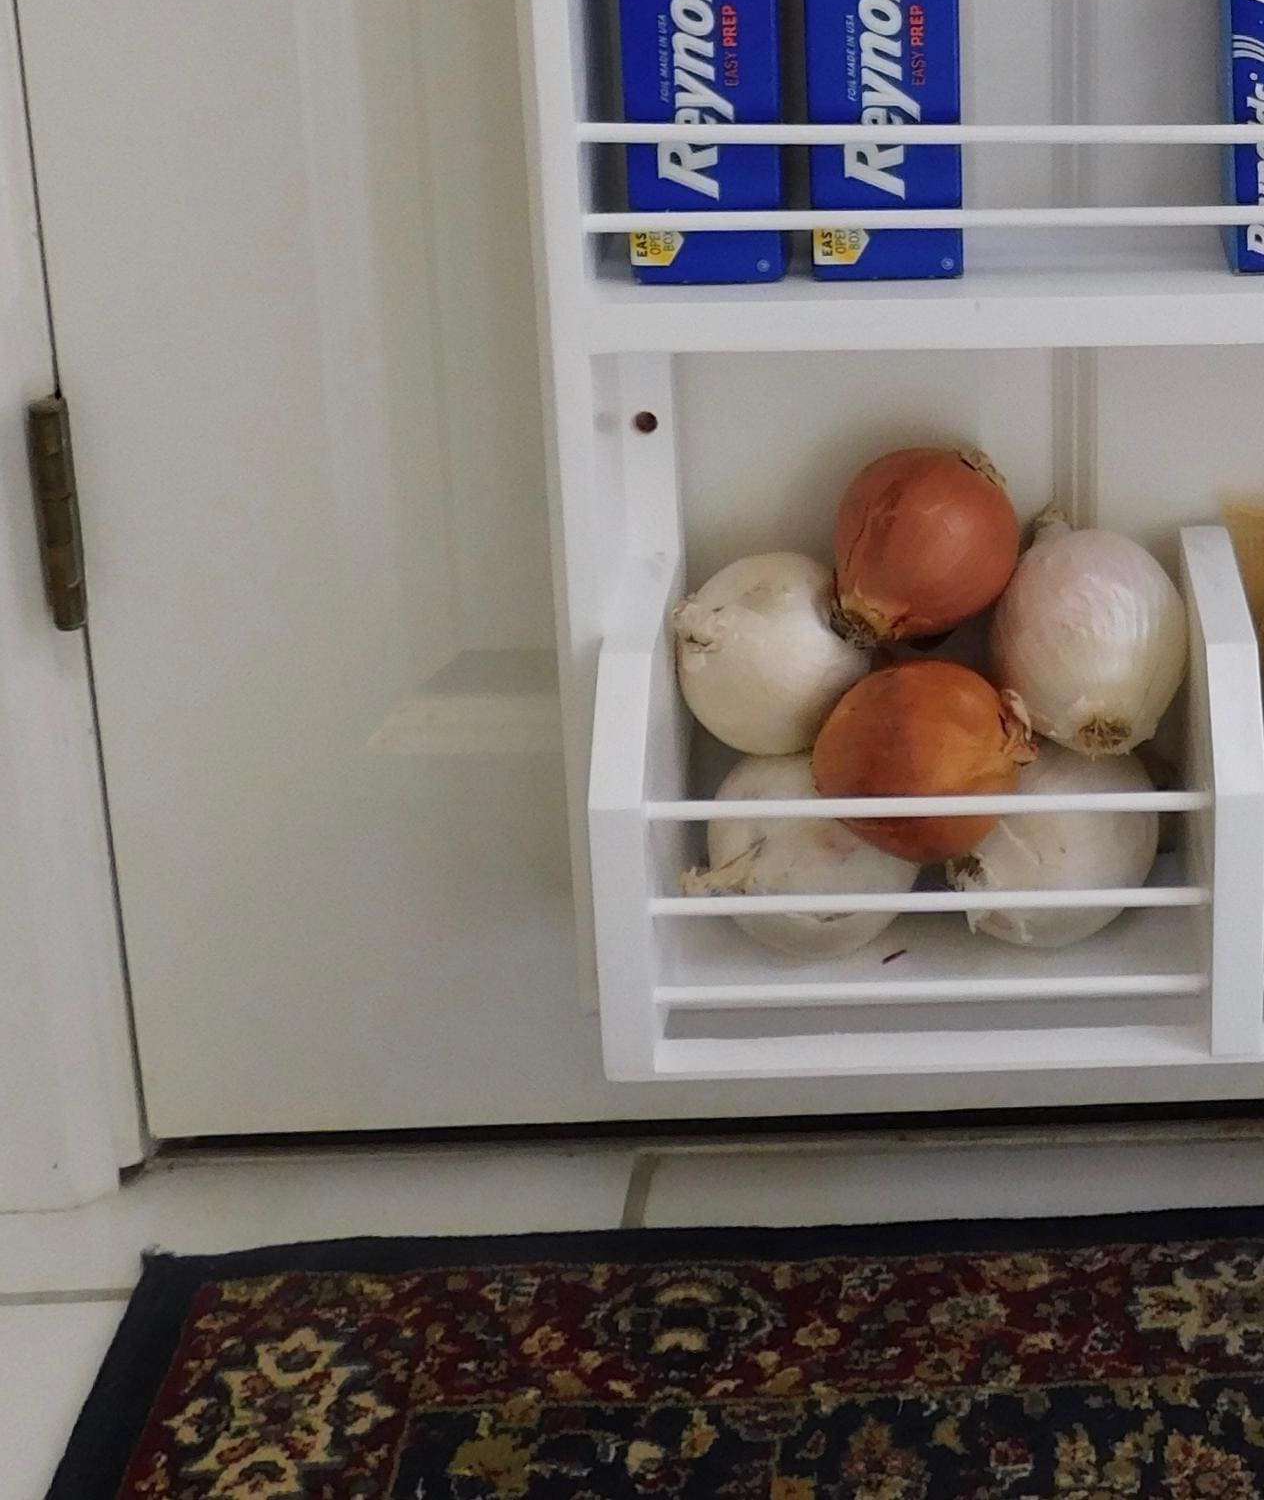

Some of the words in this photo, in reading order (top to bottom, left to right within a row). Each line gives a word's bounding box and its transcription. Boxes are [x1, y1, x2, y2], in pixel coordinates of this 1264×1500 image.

[722, 4, 738, 48] PREP
[910, 4, 924, 47] PREP
[658, 36, 667, 48] IN
[846, 36, 855, 48] IN
[658, 49, 669, 79] MADE
[723, 50, 739, 87] EASY
[847, 49, 856, 80] MADE
[911, 48, 926, 86] EASY
[635, 231, 648, 259] EAS
[822, 230, 833, 258] EAS
